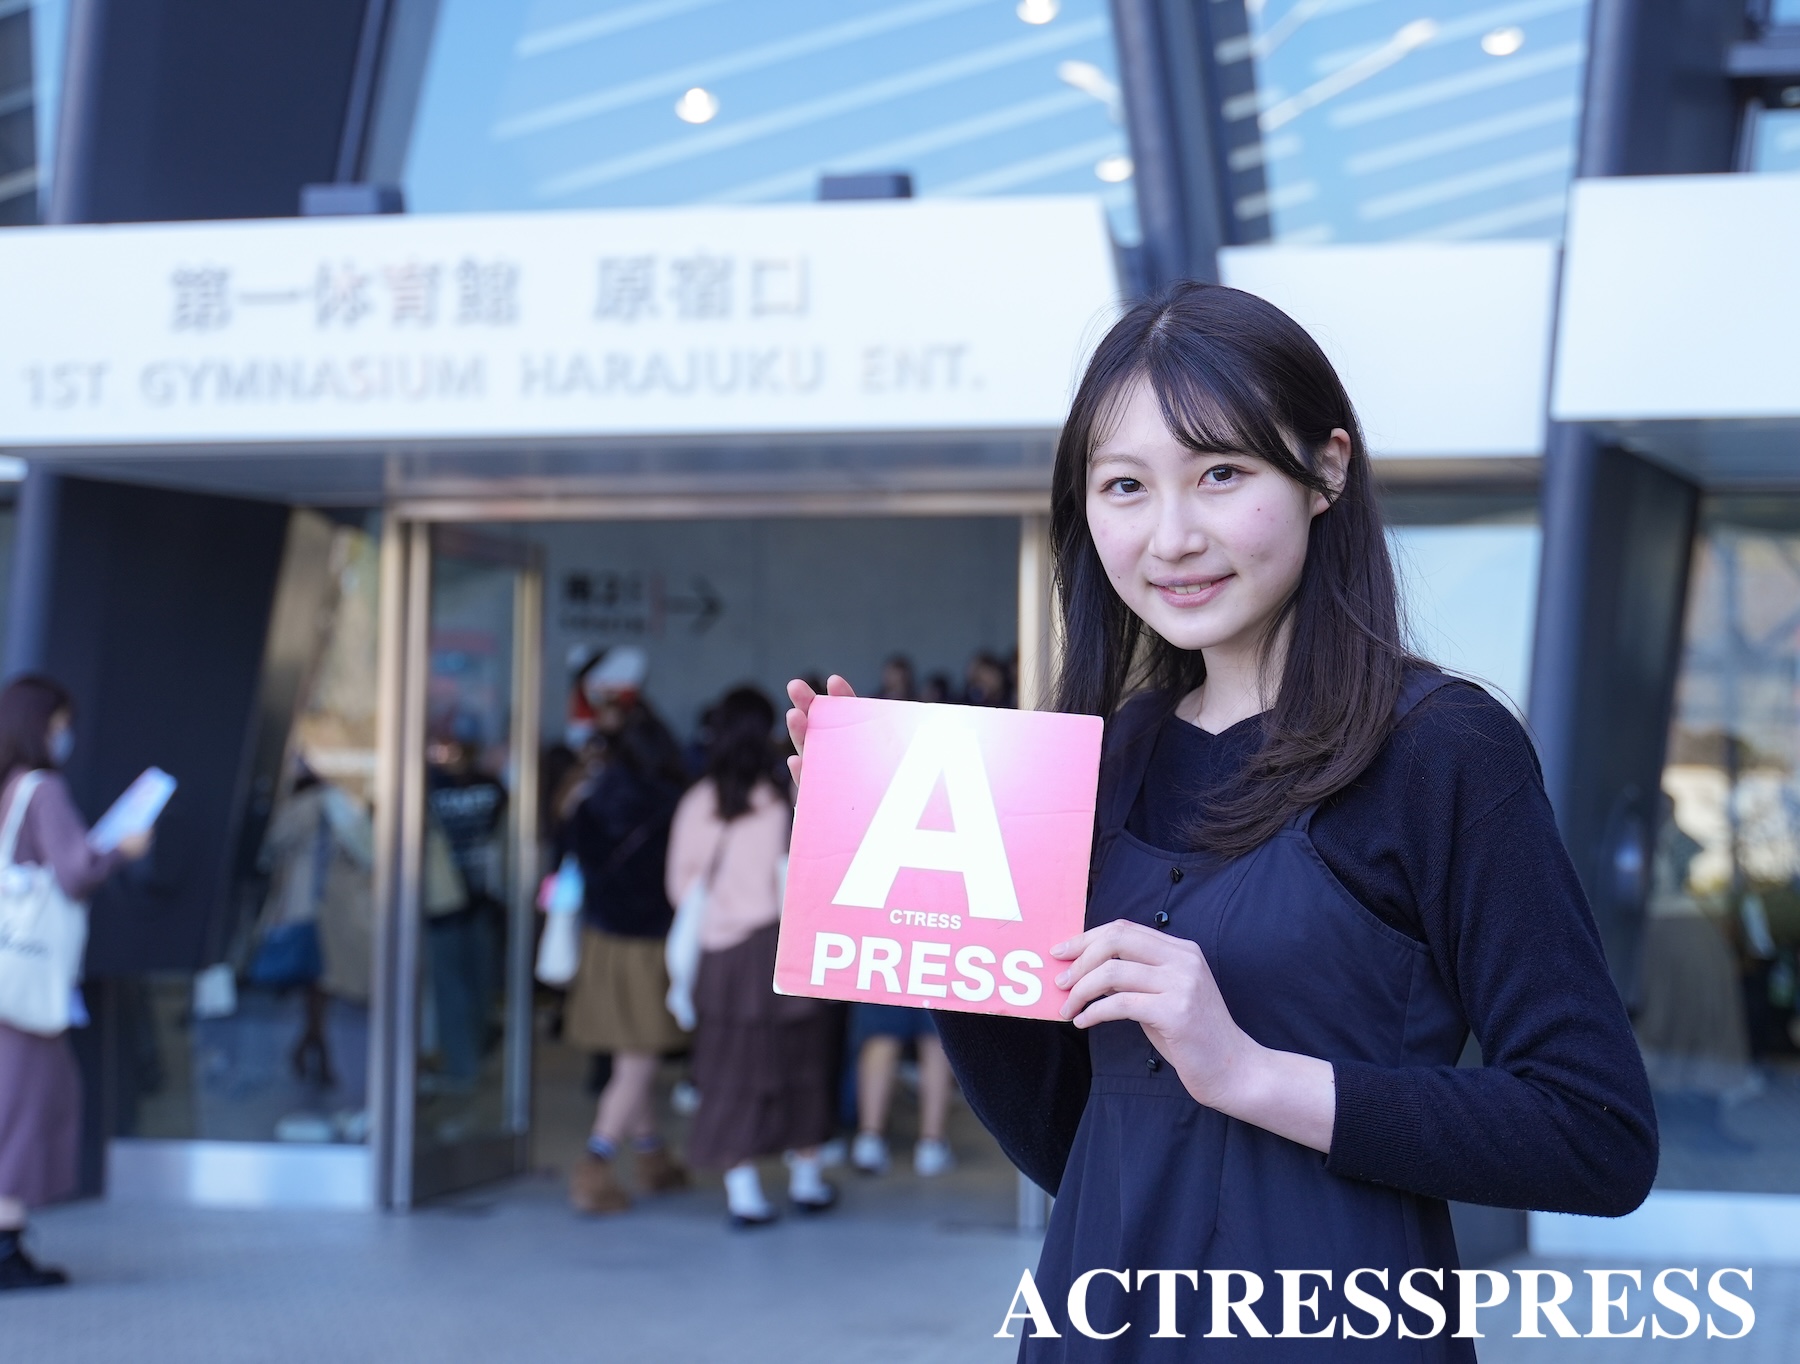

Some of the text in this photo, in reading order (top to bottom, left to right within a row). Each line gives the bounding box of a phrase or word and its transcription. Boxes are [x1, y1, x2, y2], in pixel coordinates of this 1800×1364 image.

[172, 250, 811, 331] 第一体育館 原宿口
[24, 344, 985, 408] 1ST GYMNASIUM HARAJUKU ENT.
[831, 724, 1023, 922] A
[889, 909, 962, 930] CTRESS
[809, 931, 1044, 1007] PRESS
